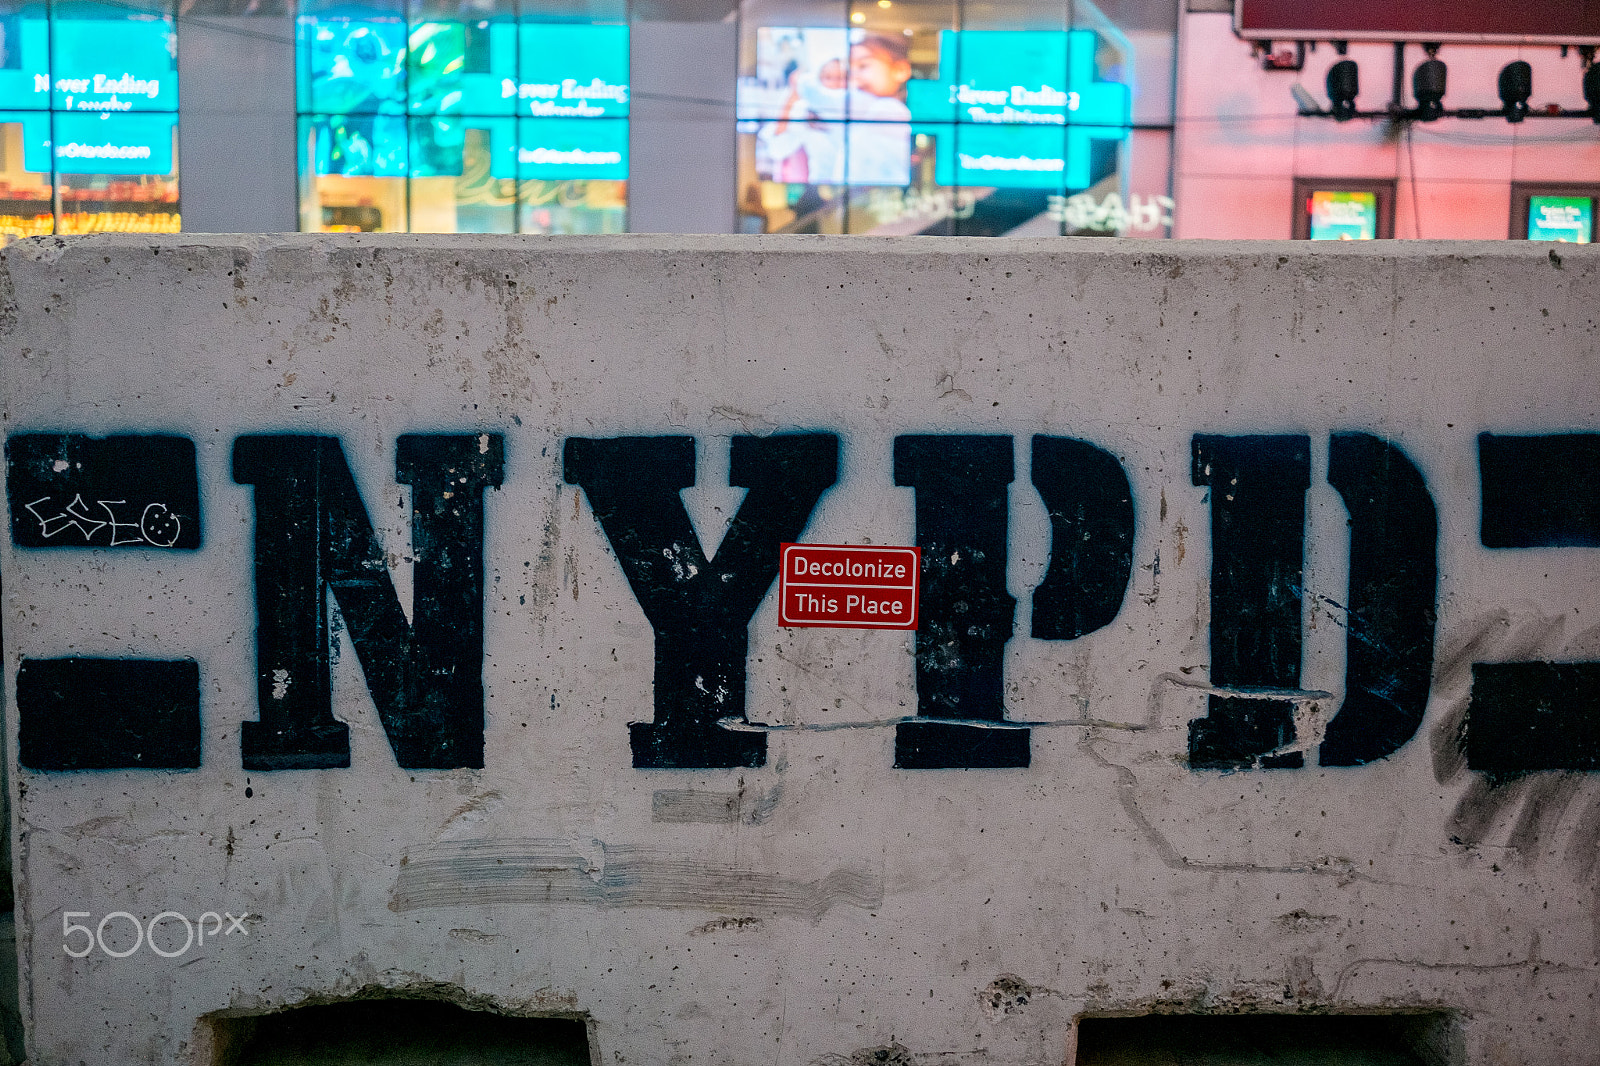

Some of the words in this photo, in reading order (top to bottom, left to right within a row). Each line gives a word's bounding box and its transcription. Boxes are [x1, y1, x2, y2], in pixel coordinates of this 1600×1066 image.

[794, 556, 906, 578] Decolonize
[231, 431, 1438, 770] NYPD
[795, 593, 838, 613] This
[846, 595, 903, 615] Place
